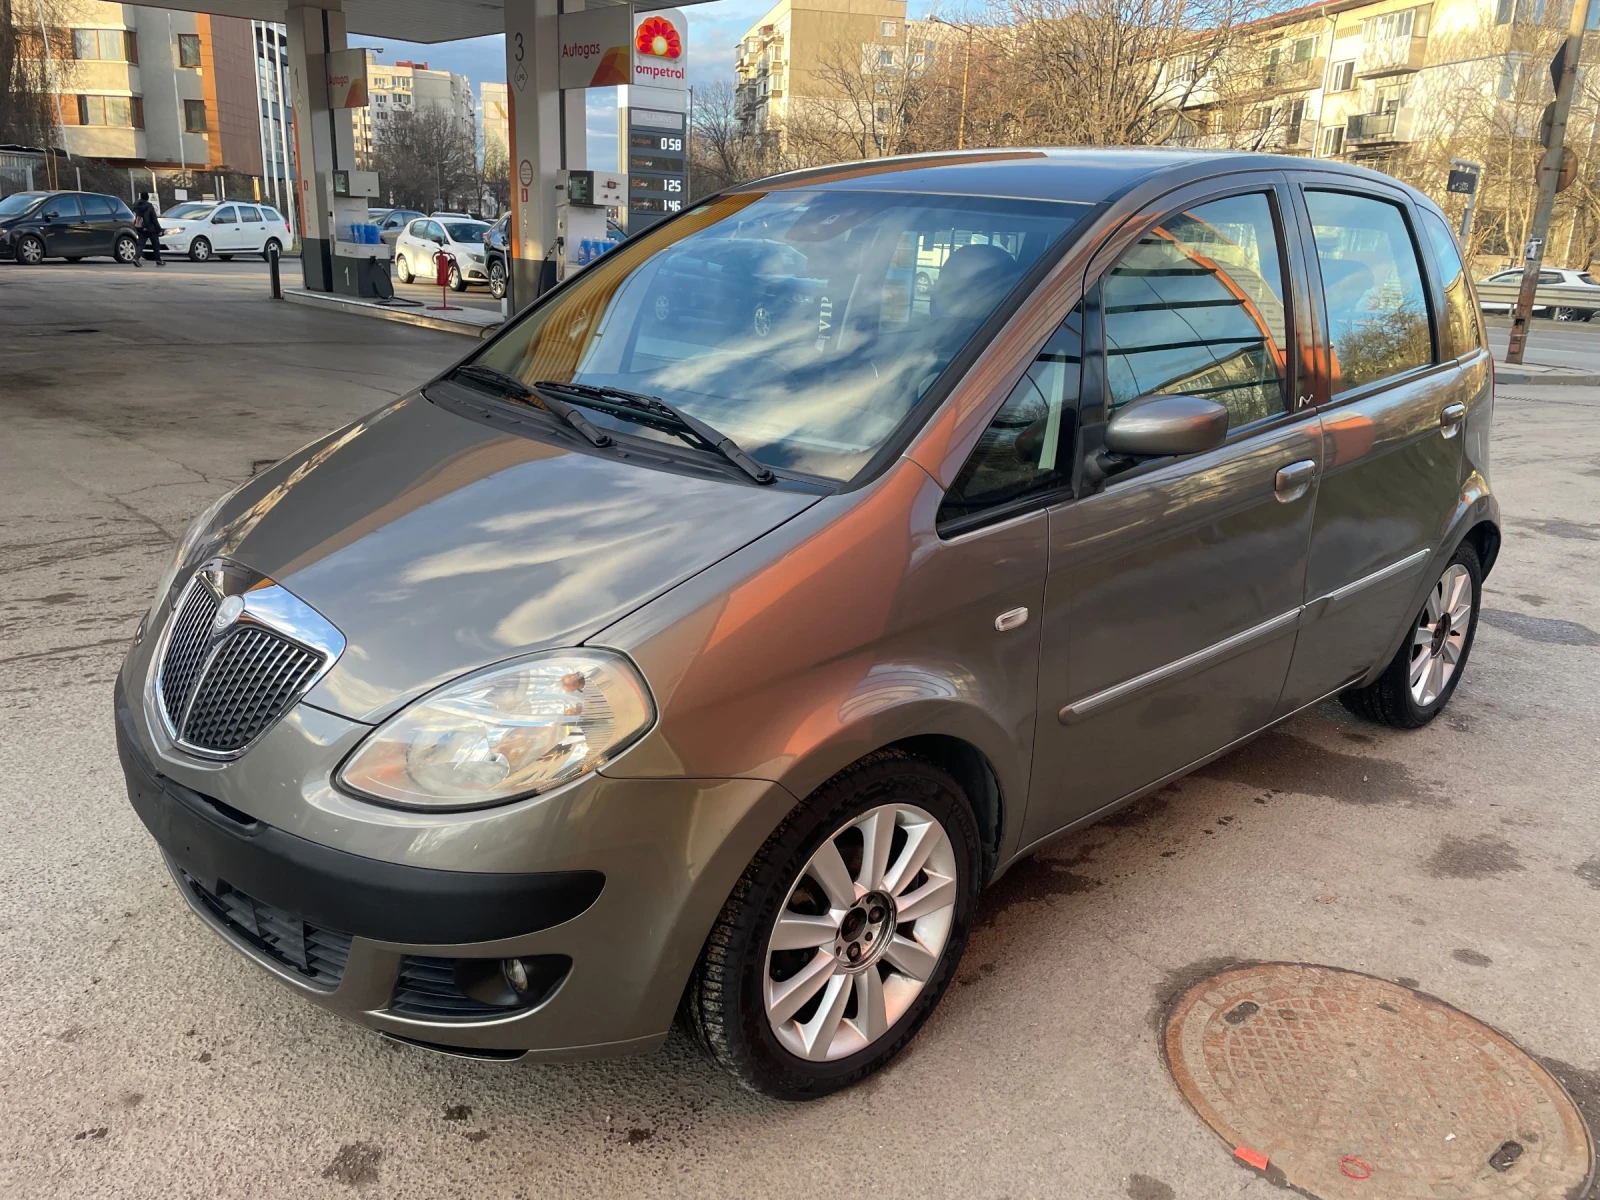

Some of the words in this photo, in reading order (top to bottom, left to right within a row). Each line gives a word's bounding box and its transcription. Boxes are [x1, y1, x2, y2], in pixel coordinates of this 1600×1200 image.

[515, 32, 524, 62] 3
[562, 43, 600, 59] Autogas
[635, 65, 684, 79] ompetrol
[329, 75, 349, 87] Autogas
[663, 179, 682, 192] 125
[663, 199, 681, 212] 146
[344, 266, 350, 286] 1
